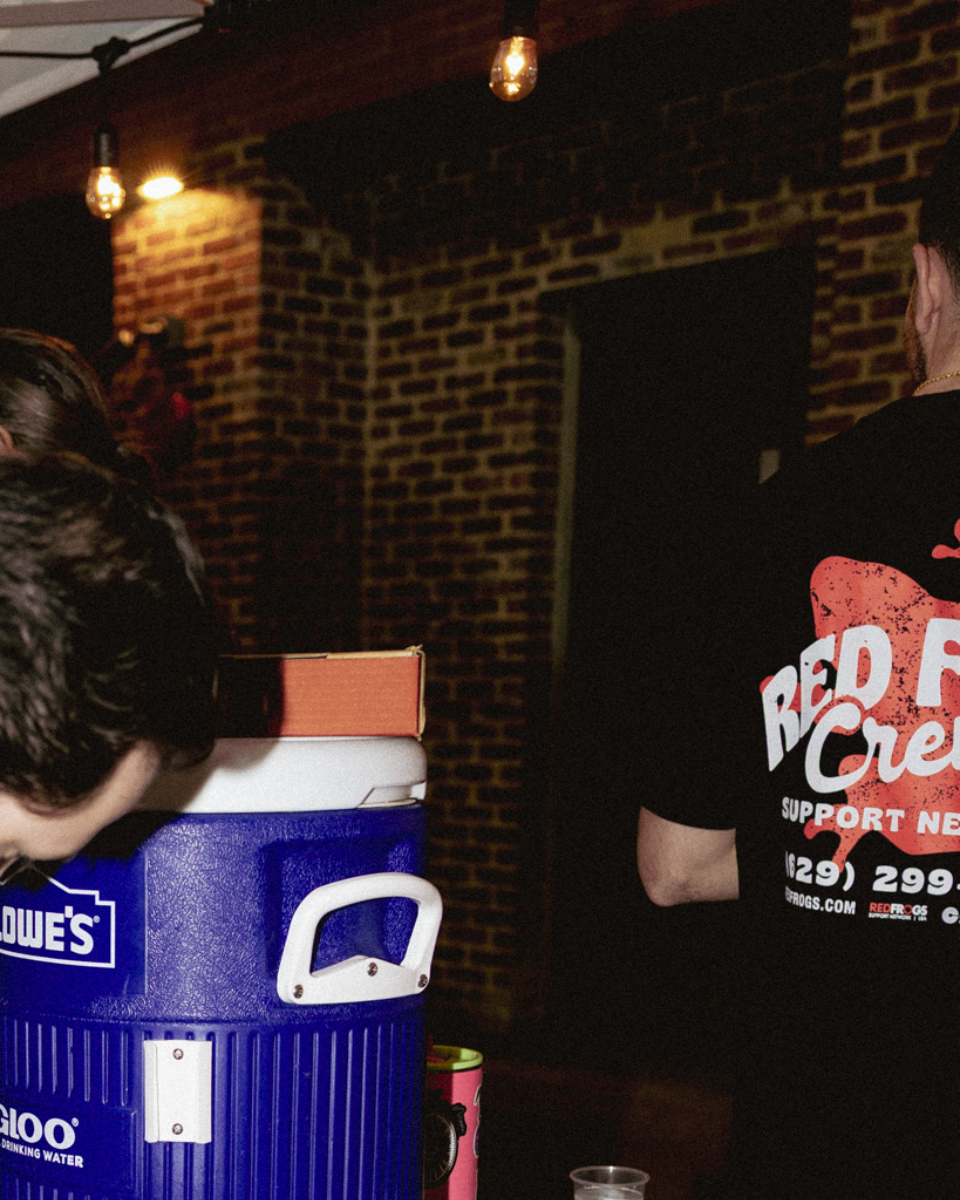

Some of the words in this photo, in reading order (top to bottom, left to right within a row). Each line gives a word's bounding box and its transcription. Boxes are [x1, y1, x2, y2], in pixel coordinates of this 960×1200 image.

[760, 624, 893, 771] RED
[805, 702, 960, 794] Cre
[782, 797, 905, 832] SUPPORT
[785, 850, 855, 891] (629)
[872, 865, 960, 896] 299
[869, 902, 928, 916] REDFROGS
[1, 1138, 41, 1159] DRINKING
[42, 1149, 84, 1168] WATER
